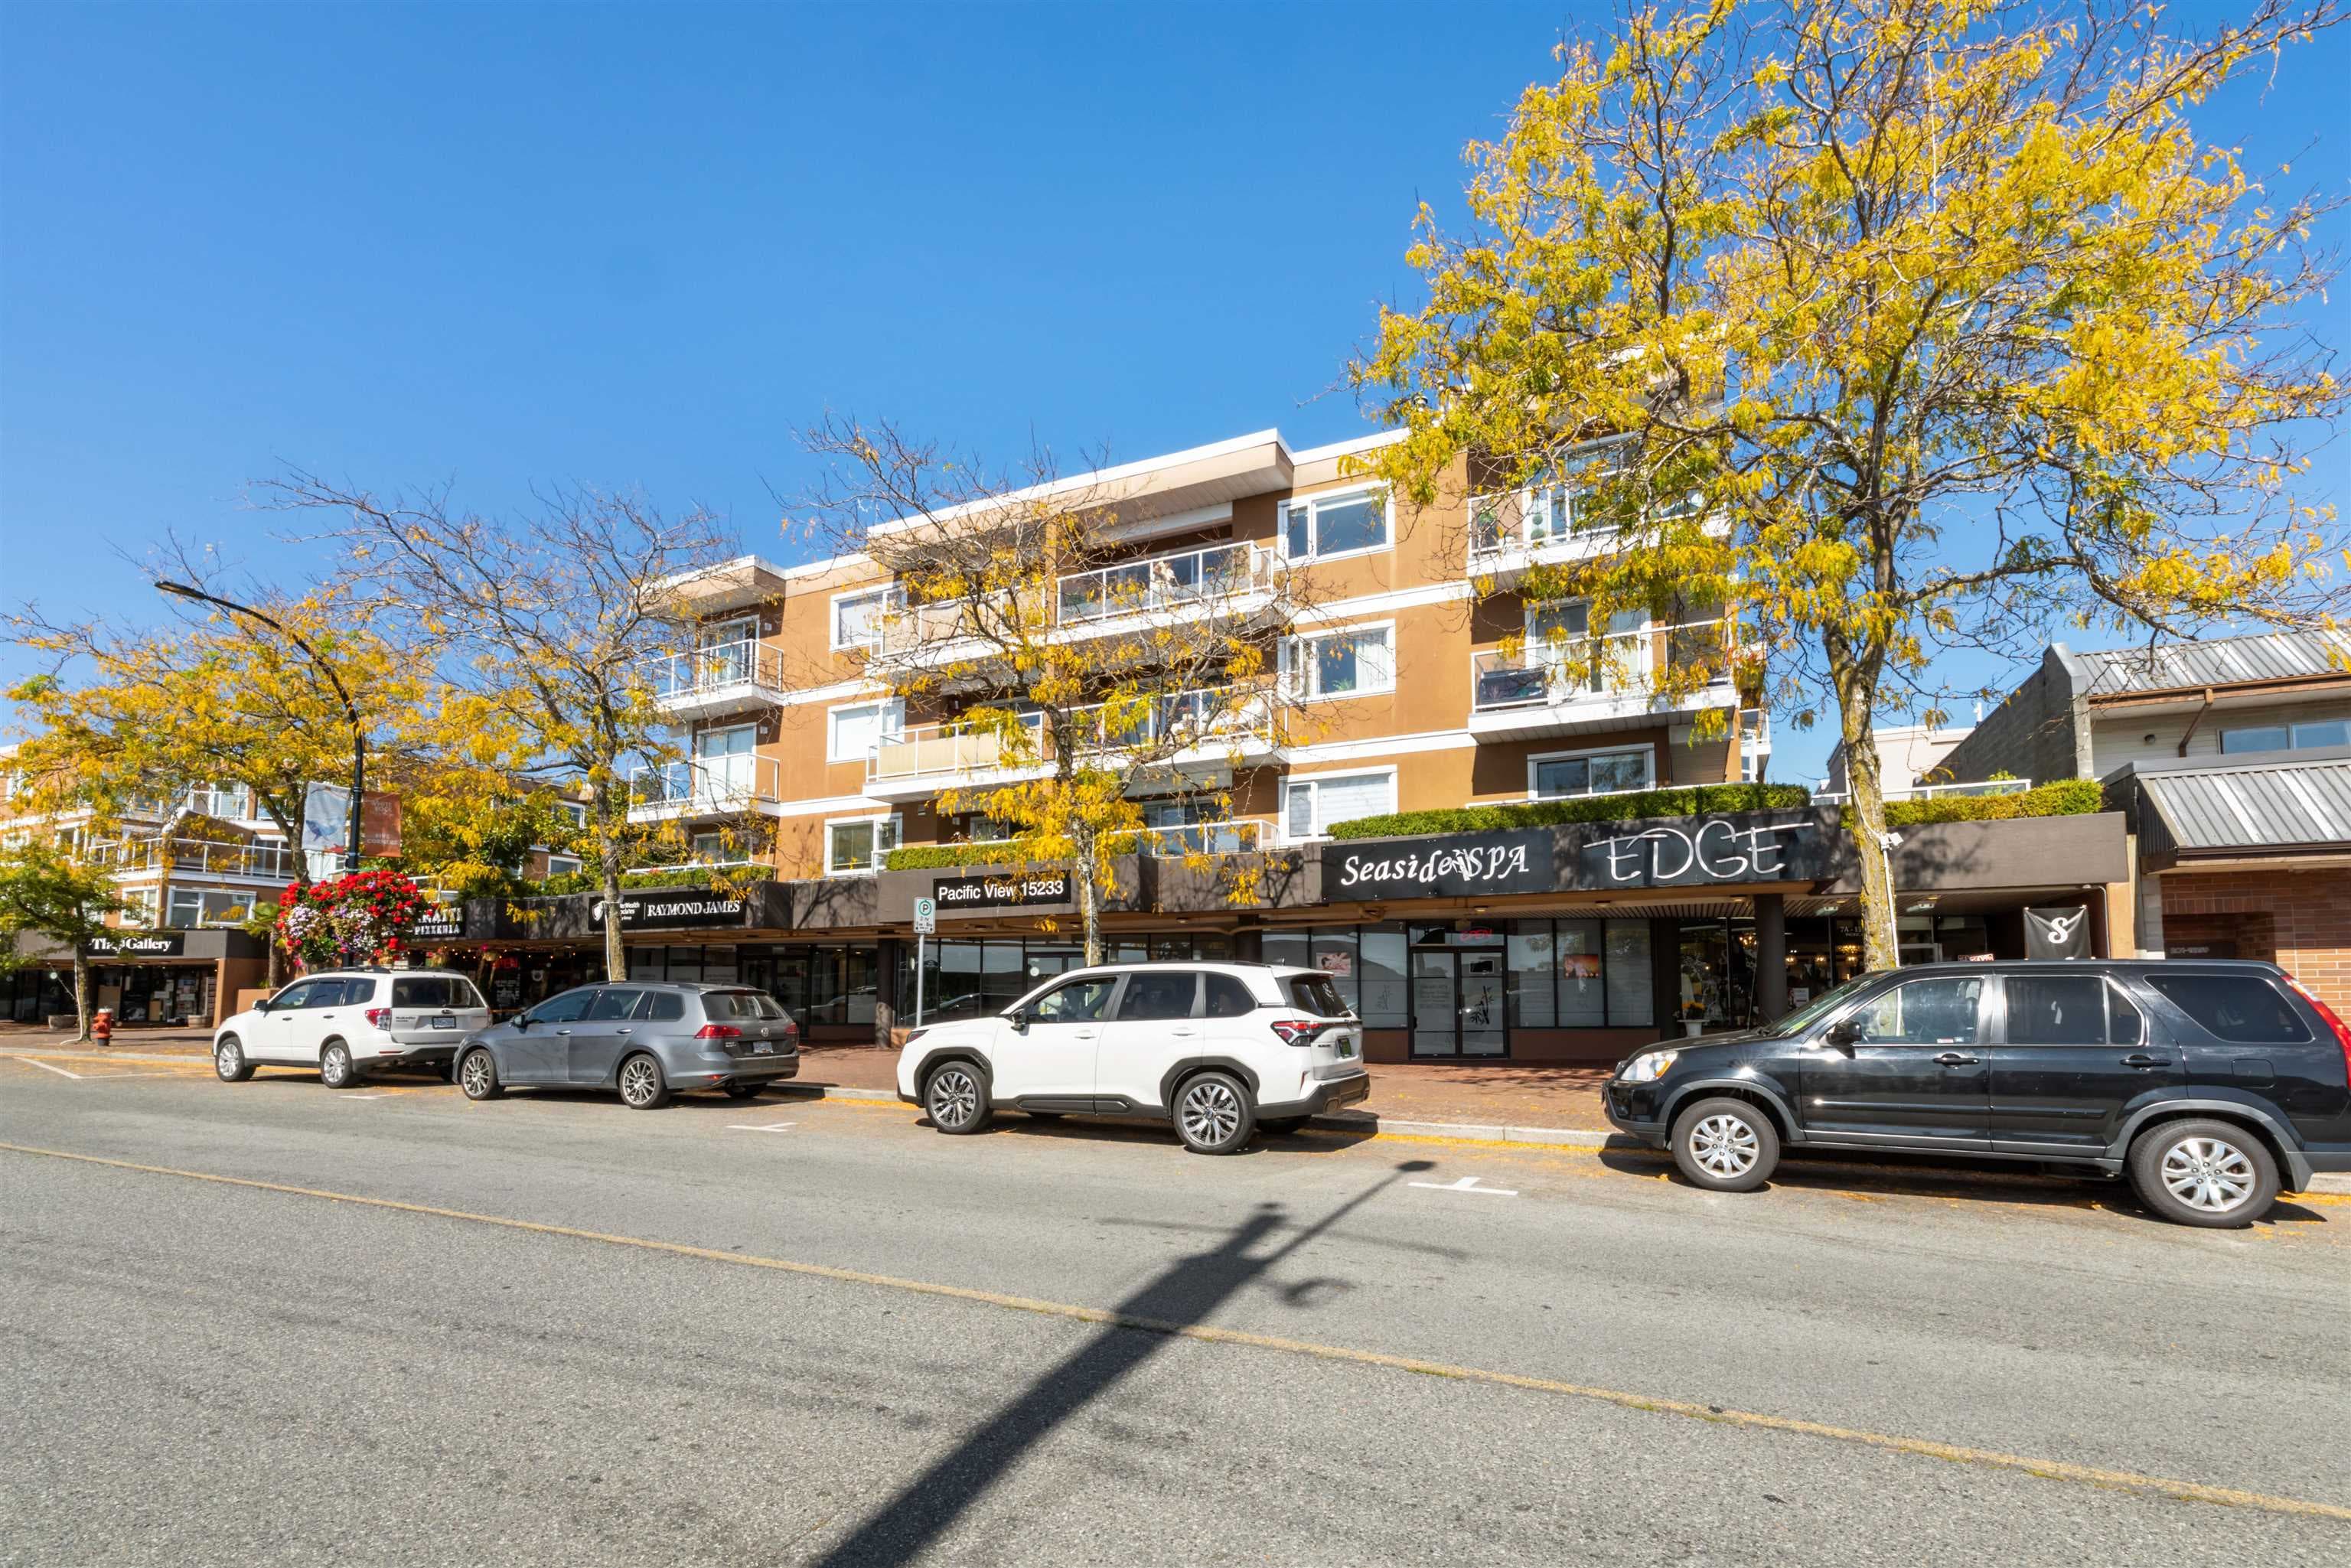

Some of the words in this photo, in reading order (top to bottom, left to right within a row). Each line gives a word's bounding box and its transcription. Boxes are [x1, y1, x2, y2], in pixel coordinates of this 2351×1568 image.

[1583, 820, 1815, 881] EDGE
[1341, 849, 1453, 886] Seaside
[1467, 844, 1530, 880] SPA
[938, 885, 981, 901] Pacific
[983, 884, 1017, 898] View
[1021, 880, 1064, 896] 15233
[647, 901, 703, 917] RAYMOND
[703, 900, 741, 914] JAMES
[922, 904, 929, 912] P
[414, 924, 461, 935] PIZZERIA
[126, 937, 171, 952] Gallery
